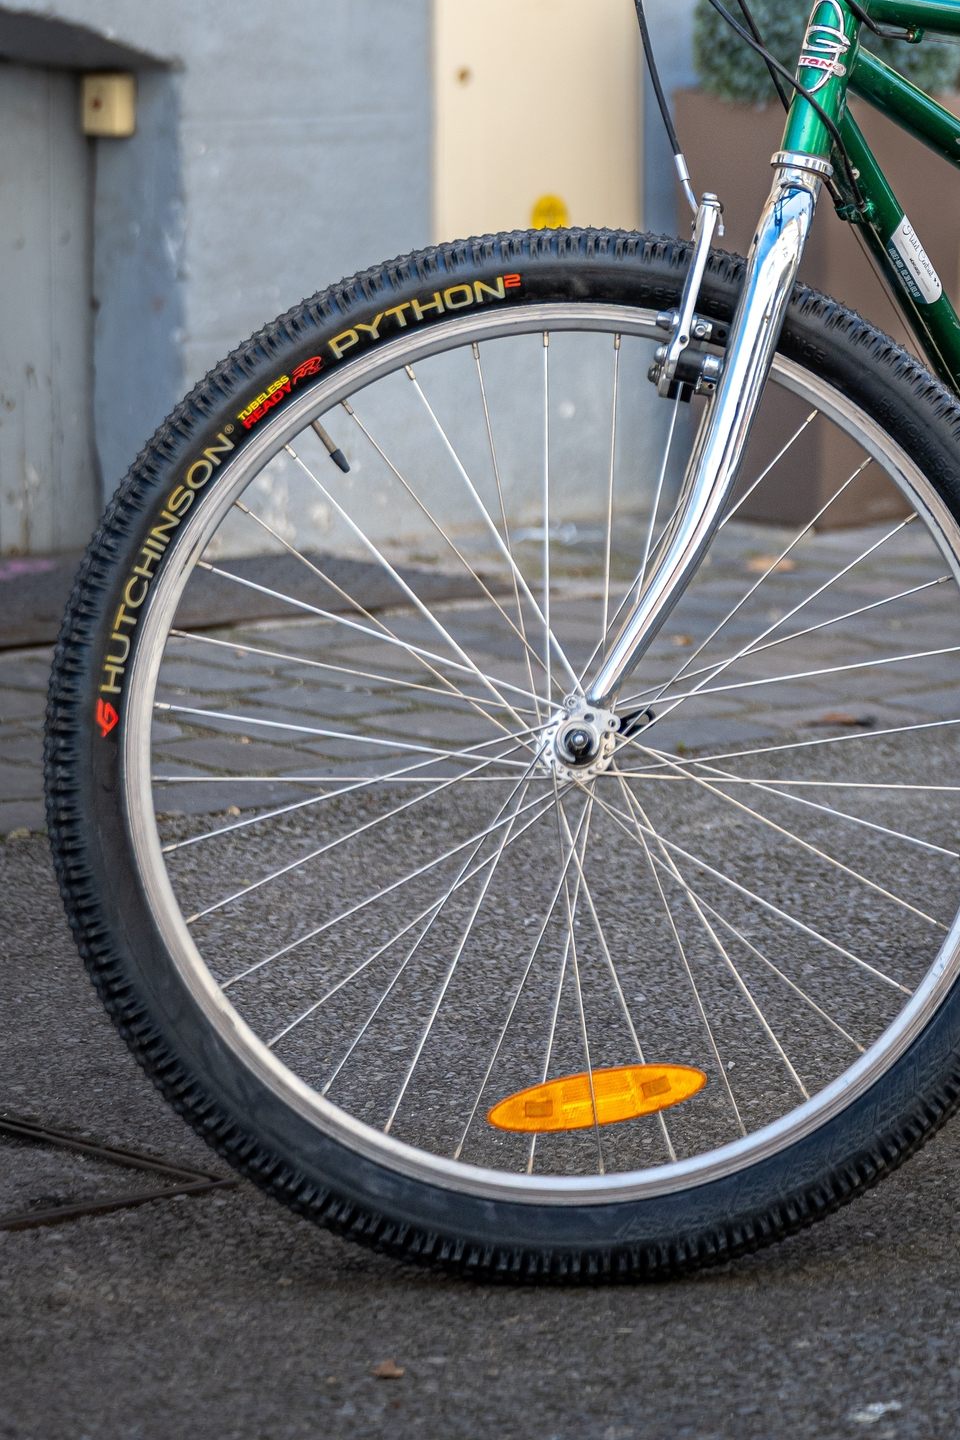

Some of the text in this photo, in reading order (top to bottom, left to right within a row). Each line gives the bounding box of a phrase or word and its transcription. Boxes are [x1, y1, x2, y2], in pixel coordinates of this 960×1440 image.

[237, 375, 290, 420] TUBELESS
[242, 380, 291, 429] READY
[101, 432, 235, 694] HUTCHINSON
